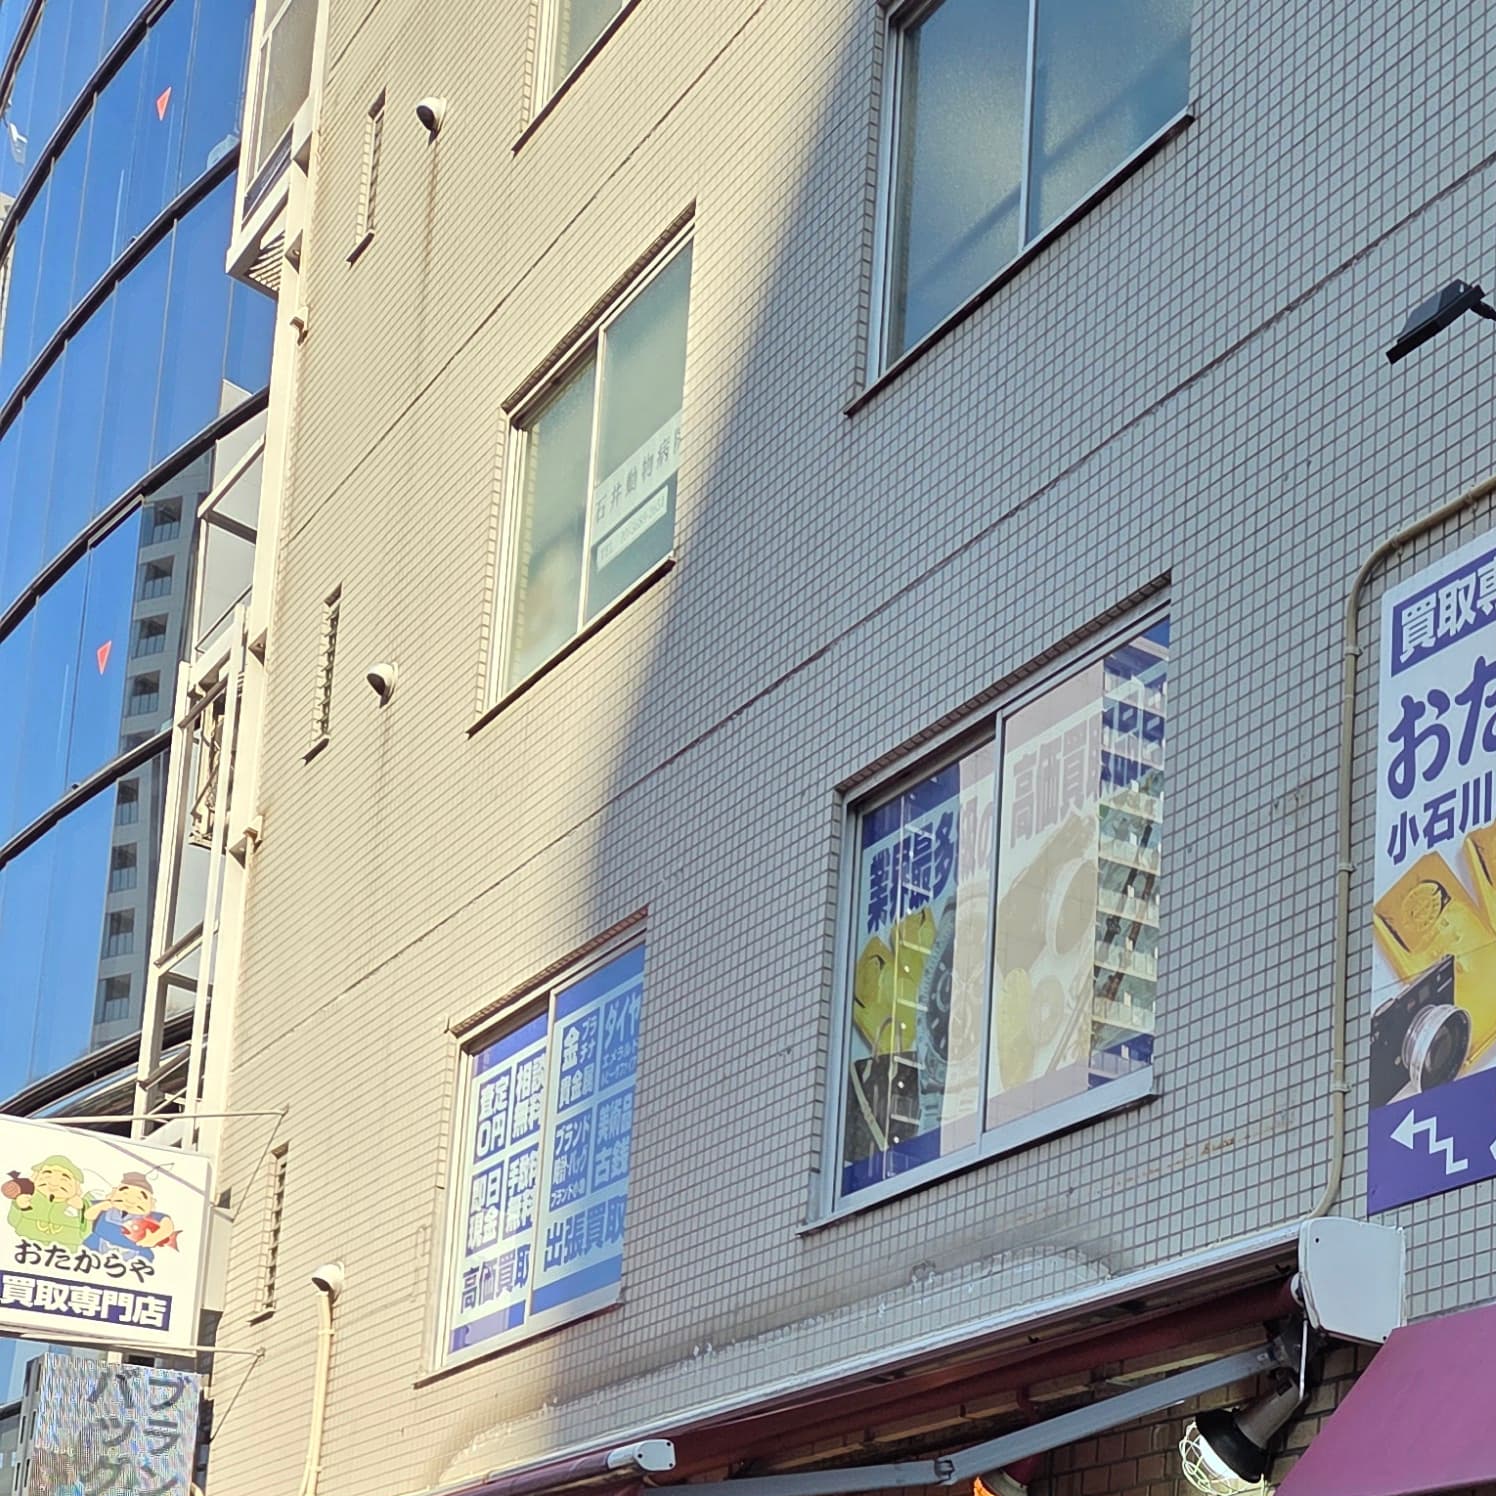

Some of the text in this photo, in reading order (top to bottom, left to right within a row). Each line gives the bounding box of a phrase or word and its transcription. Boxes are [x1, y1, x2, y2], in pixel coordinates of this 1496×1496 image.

[604, 992, 641, 1050] ダイヤ
[562, 1026, 580, 1072] 金
[479, 1075, 510, 1122] 査定
[476, 1110, 507, 1158] 0円
[555, 1113, 591, 1156] ブランド
[471, 1170, 501, 1214] 即日
[468, 1206, 499, 1250] 現金
[544, 1194, 627, 1272] 出張買取
[14, 1239, 155, 1284] おたからや
[460, 1243, 531, 1314] 高価買取
[1, 1273, 168, 1328] 買取専門店
